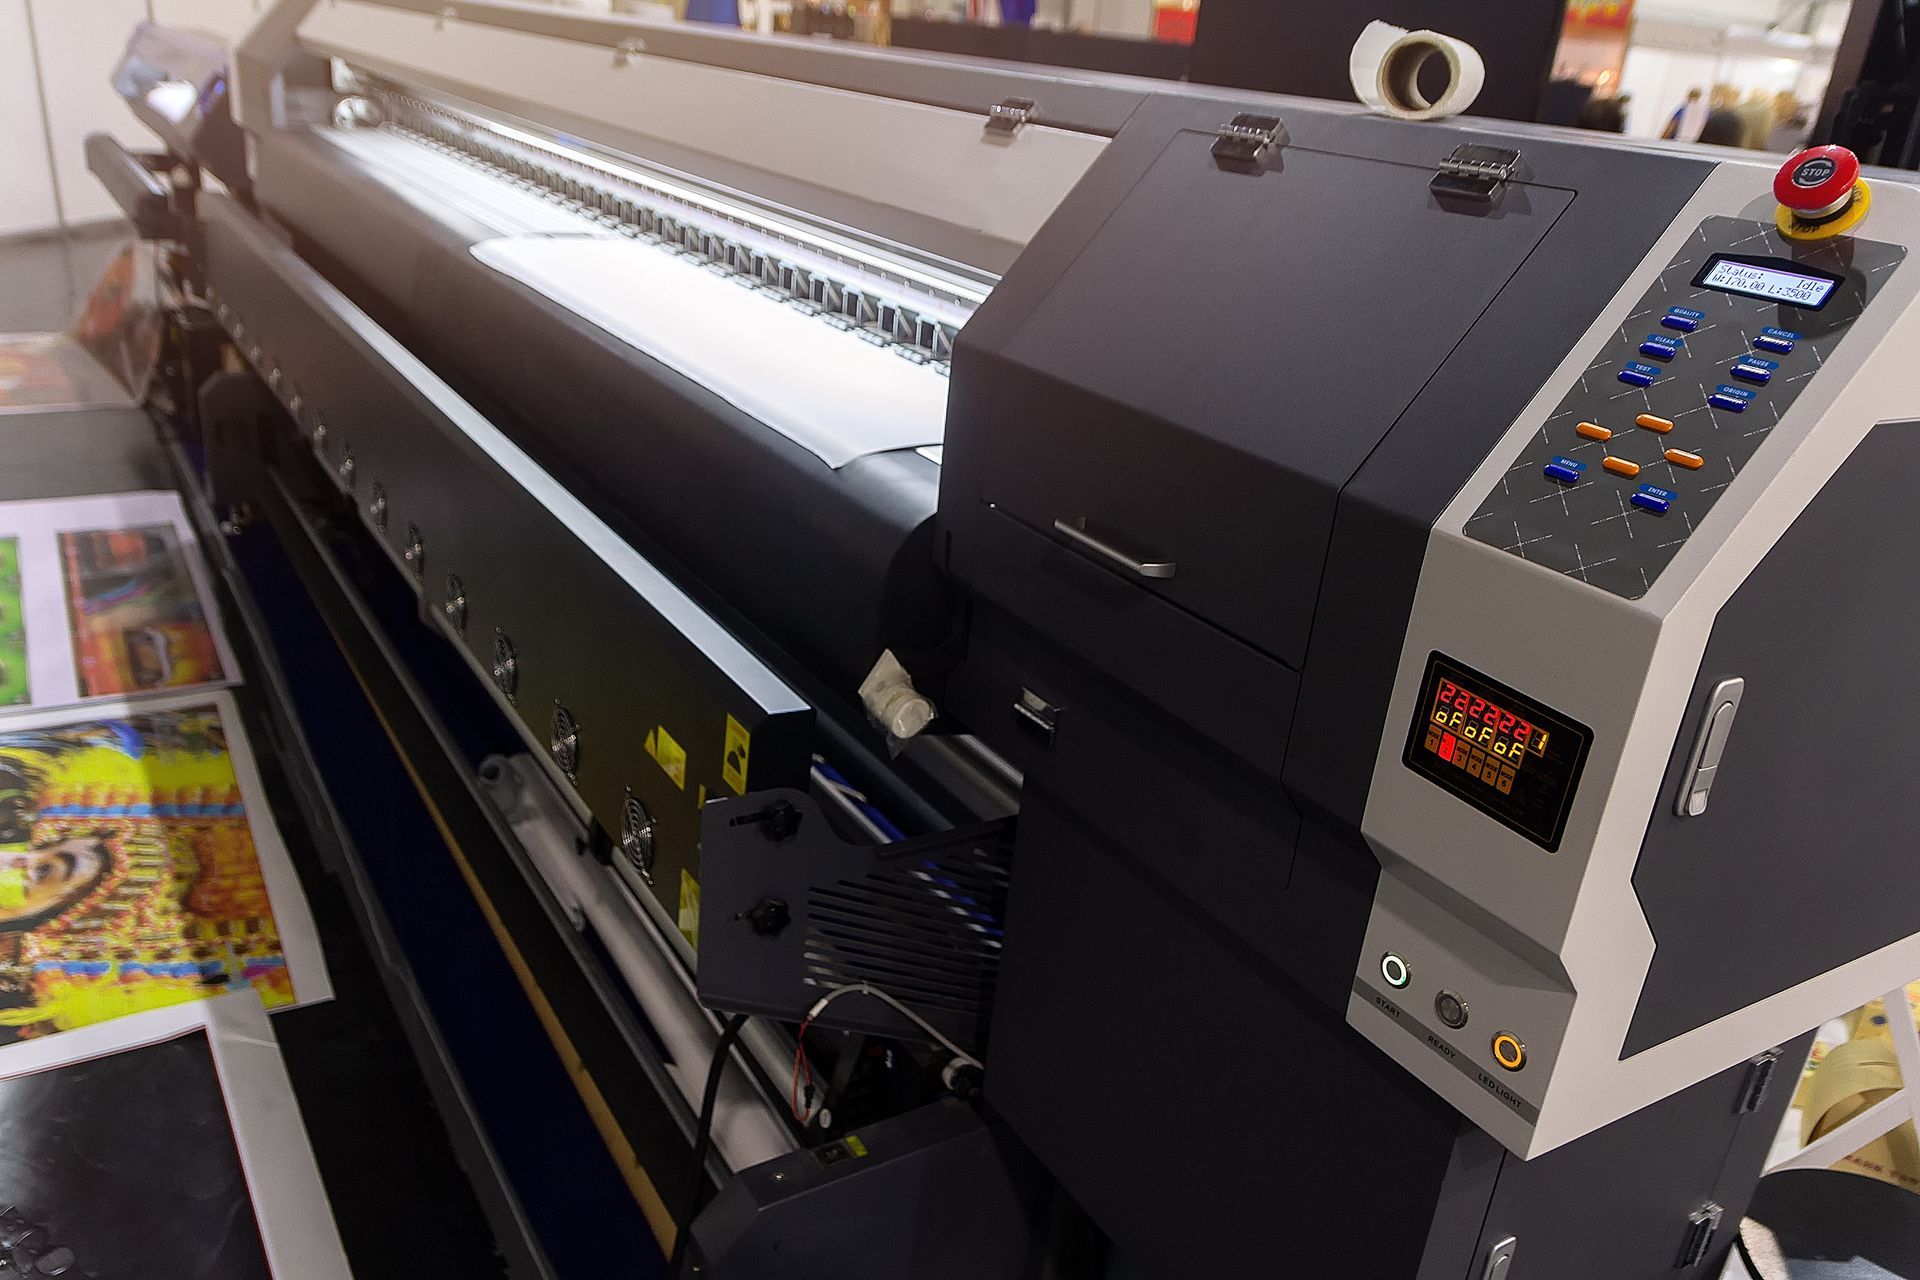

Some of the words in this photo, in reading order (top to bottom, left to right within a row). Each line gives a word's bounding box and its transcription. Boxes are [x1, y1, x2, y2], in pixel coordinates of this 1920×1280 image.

[1801, 168, 1830, 177] STOP
[1717, 264, 1764, 280] Status:
[1796, 279, 1825, 292] Idle
[1768, 284, 1812, 300] L:3500
[1674, 308, 1700, 318] QUALITY
[1767, 328, 1794, 339] CANCEL
[1654, 335, 1676, 345] CLEAN
[1635, 362, 1652, 373] TEST
[1748, 357, 1770, 368] PAUSE
[1723, 385, 1749, 397] ORIGIN
[1560, 458, 1578, 469] MENU
[1648, 486, 1668, 497] ENTER
[1375, 997, 1401, 1018] START
[1428, 1035, 1457, 1059] READY
[1478, 1072, 1496, 1089] LED
[1495, 1086, 1522, 1109] LIGHT
